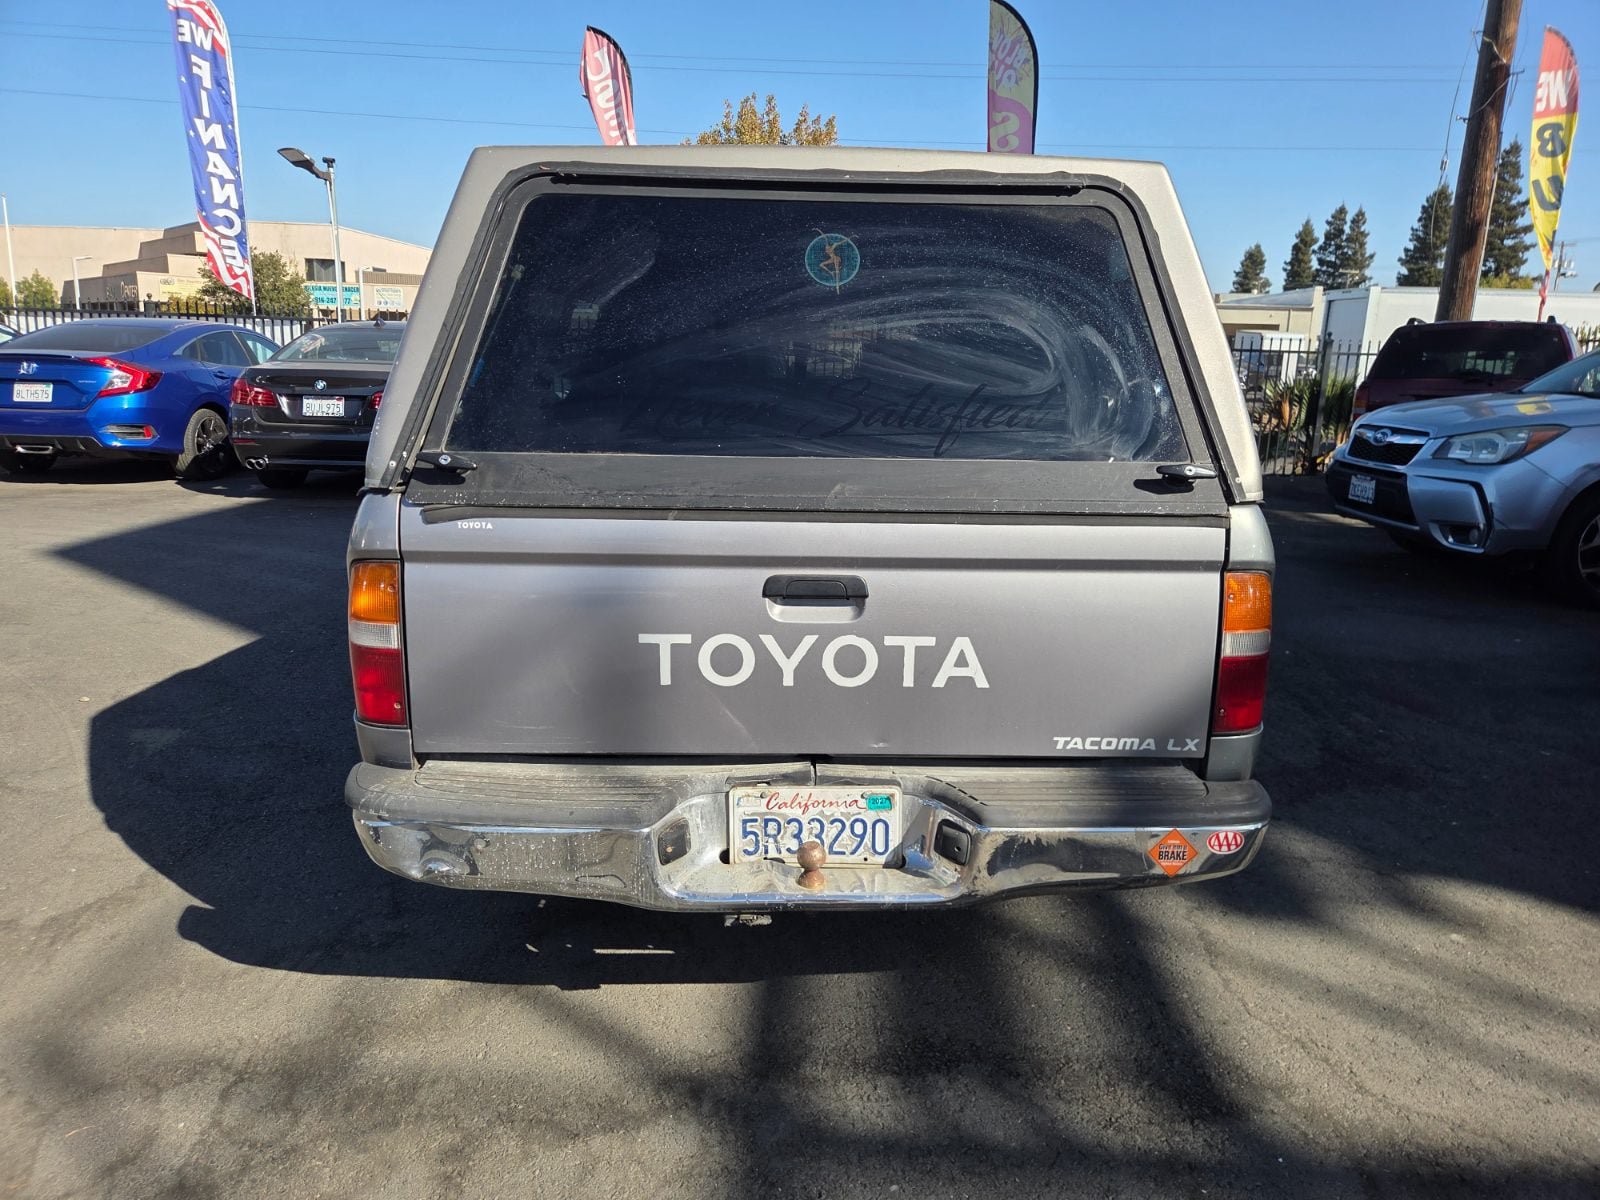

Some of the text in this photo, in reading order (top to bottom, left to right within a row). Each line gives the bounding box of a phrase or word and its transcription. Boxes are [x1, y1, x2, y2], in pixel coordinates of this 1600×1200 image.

[457, 521, 493, 529] TOYOTA
[638, 633, 990, 688] TOYOTA
[1052, 736, 1200, 751] TACOMA LX
[765, 791, 867, 815] California
[741, 817, 890, 856] 5R33290
[1212, 832, 1241, 852] AAA
[1158, 851, 1187, 861] BRAKE
